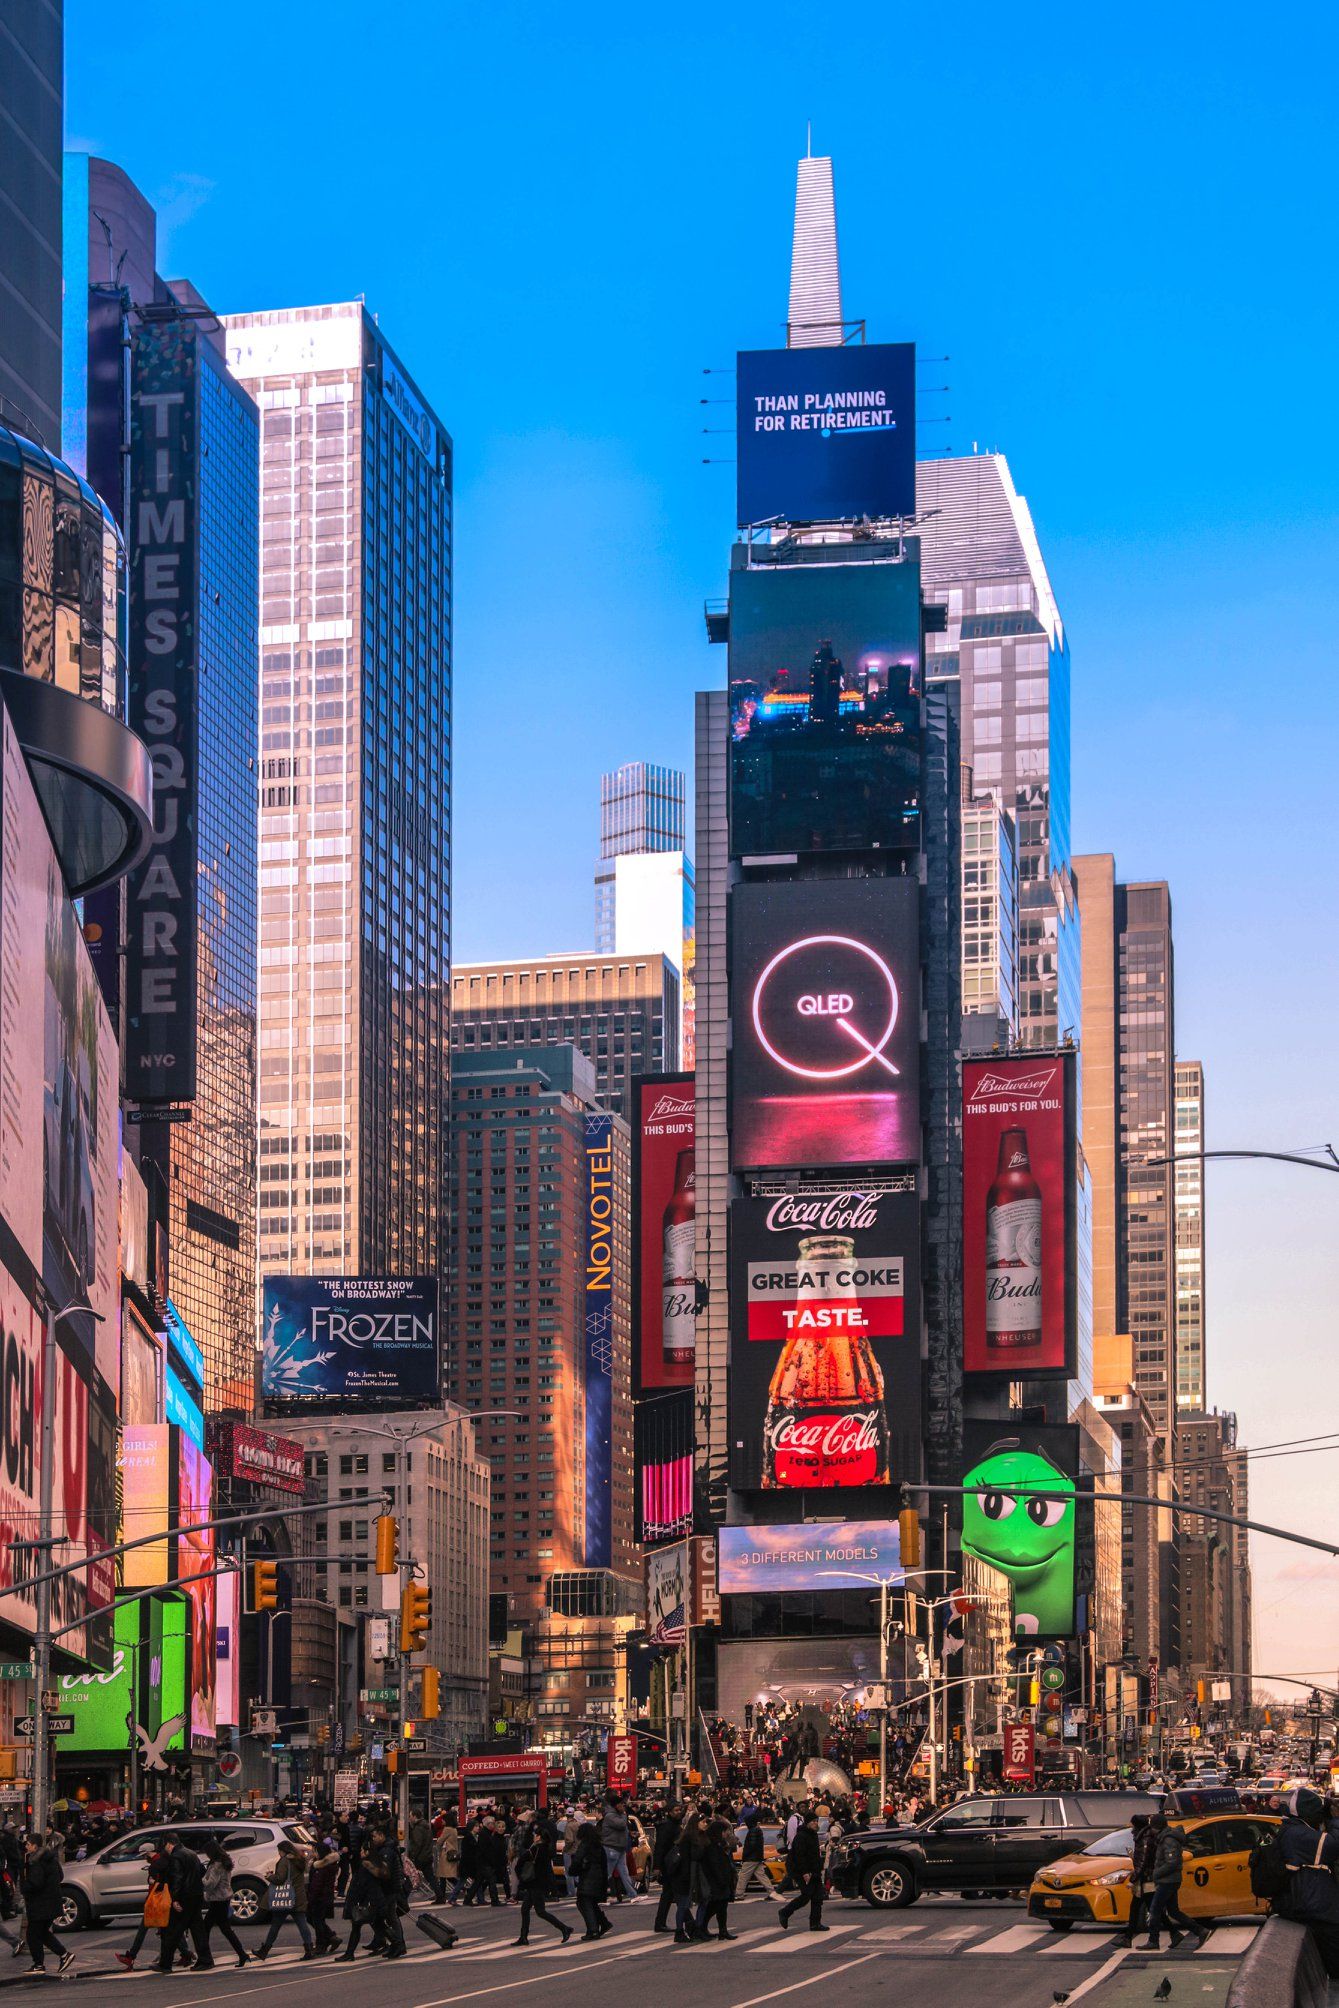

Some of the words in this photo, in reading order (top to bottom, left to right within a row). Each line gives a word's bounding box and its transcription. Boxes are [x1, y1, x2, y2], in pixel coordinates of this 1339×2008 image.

[754, 395, 799, 412] THAN
[804, 391, 886, 410] PLANNING
[754, 415, 785, 432] FOR
[791, 410, 896, 430] RETIREMENT.
[139, 392, 185, 655] TIMES
[137, 689, 187, 1014] SQUARE
[797, 994, 854, 1015] QLED
[140, 1053, 176, 1068] NYC
[977, 1078, 1048, 1093] Budweiser
[966, 1104, 987, 1114] THIS
[989, 1102, 1018, 1112] BUD'S
[1020, 1101, 1038, 1111] FOR
[1039, 1099, 1062, 1109] YOU.
[643, 1126, 664, 1135] THIS
[666, 1124, 693, 1134] BUD'S
[586, 1134, 612, 1290] NOVOTEL
[766, 1192, 883, 1232] Coca-Cola
[343, 1281, 384, 1290] HOTTEST
[387, 1281, 414, 1290] SNOW
[752, 1272, 830, 1290] GREAT
[836, 1268, 900, 1287] COKE
[332, 1290, 345, 1298] ON
[311, 1306, 433, 1349] FROZEN
[782, 1308, 869, 1328] TASTE.
[741, 1553, 749, 1565] 3
[752, 1549, 821, 1564] DIFFERENT
[825, 1548, 878, 1561] MODELS
[8, 1663, 21, 1678] 45
[369, 1690, 377, 1700] W
[379, 1690, 389, 1699] 45
[1011, 1727, 1030, 1763] tkts
[462, 1761, 499, 1770] COFFEED
[615, 1739, 633, 1774] tkts
